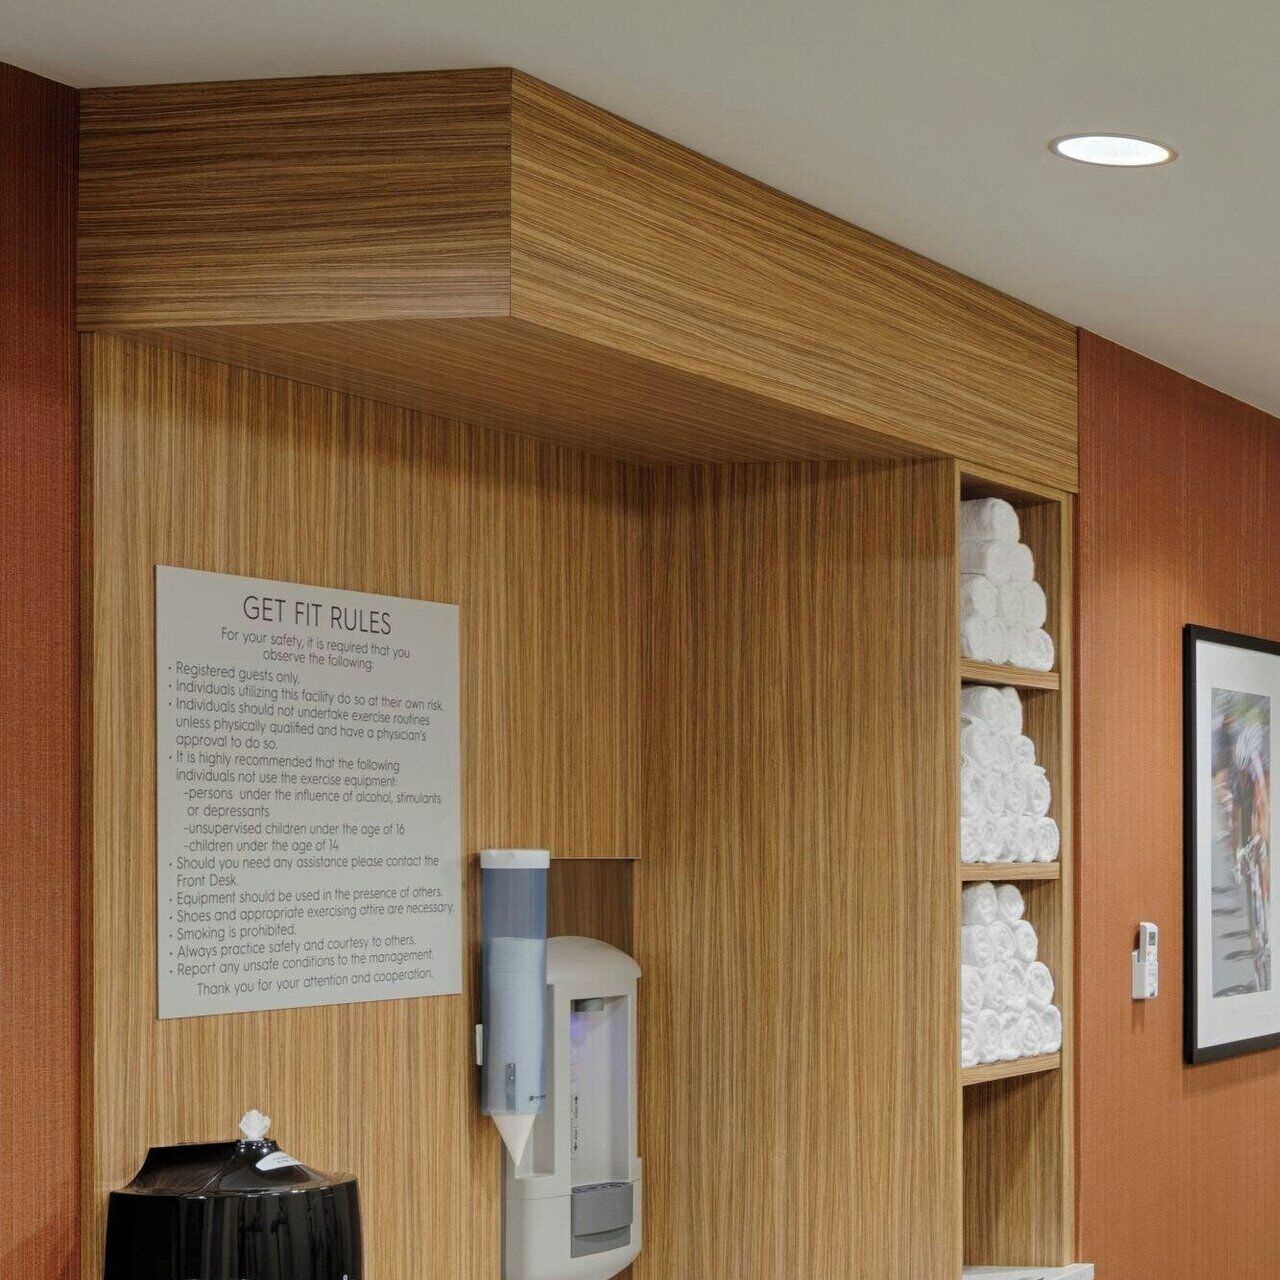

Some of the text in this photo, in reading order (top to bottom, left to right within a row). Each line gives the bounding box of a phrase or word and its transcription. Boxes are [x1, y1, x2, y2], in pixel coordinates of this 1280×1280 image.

[244, 596, 391, 635] GET FIT RULES
[221, 628, 409, 659] For your safety, it is required that you
[263, 650, 305, 663] observe
[309, 654, 324, 664] the
[176, 661, 299, 685] Registered guests only.
[177, 682, 235, 696] Individuals
[239, 687, 278, 700] utilizing
[282, 689, 298, 700] this
[302, 689, 334, 703] facility
[338, 693, 350, 704] do
[354, 697, 365, 706] so
[368, 696, 378, 706] at
[382, 697, 401, 708] their
[405, 701, 424, 710] own
[177, 699, 430, 725] Individuals should not undertake exercise routines
[176, 716, 210, 729] unless
[214, 719, 265, 733] physically
[270, 722, 313, 735] qualified
[318, 725, 337, 736] and
[341, 727, 364, 737] have
[176, 735, 277, 750] approval to do so.
[177, 750, 399, 774] It is highly recommended that the following
[177, 769, 234, 782] individuals
[238, 772, 256, 783] not
[260, 774, 277, 783] use
[281, 772, 297, 783] the
[301, 775, 341, 785] exercise
[240, 788, 271, 800] under
[275, 789, 291, 801] the
[295, 789, 339, 802] influence
[343, 791, 352, 802] of
[356, 792, 393, 804] alcohol,
[397, 792, 441, 804] stimulants
[187, 804, 269, 818] or depressants
[265, 823, 306, 834] children
[310, 823, 338, 834] under
[343, 824, 357, 834] the
[361, 825, 380, 837] age
[383, 824, 393, 835] of
[396, 824, 405, 835] 16
[237, 840, 268, 851] under
[272, 840, 288, 851] the
[292, 841, 312, 854] age
[316, 839, 326, 850] of
[330, 839, 338, 850] 14
[177, 855, 439, 870] Should you need any assistance please contact the
[177, 874, 238, 887] Front Desk.
[177, 892, 235, 907] Equipment
[240, 891, 274, 903] should
[279, 891, 292, 902] be
[296, 890, 319, 901] used
[324, 890, 331, 900] in
[335, 889, 350, 899] the
[354, 888, 396, 901] presence
[400, 887, 409, 898] of
[177, 910, 210, 923] Shoes
[215, 909, 235, 921] and
[240, 907, 304, 922] appropriate
[308, 905, 356, 919] exercising
[360, 904, 384, 916] attire
[388, 904, 402, 915] are
[177, 924, 296, 941] Smoking is prohibited.
[177, 945, 217, 959] Always
[221, 943, 265, 958] practice
[269, 940, 300, 953] safety
[304, 939, 324, 951] and
[328, 937, 368, 950] courtesy
[373, 937, 381, 947] to
[177, 962, 215, 978] Report
[220, 961, 239, 975] any
[244, 959, 278, 972] unsafe
[283, 955, 334, 969] conditions
[339, 955, 347, 965] to
[351, 953, 366, 964] the
[198, 982, 230, 995] Thank
[235, 982, 254, 996] you
[258, 979, 272, 991] for
[276, 977, 299, 994] your
[304, 974, 349, 988] attention
[352, 972, 370, 984] and
